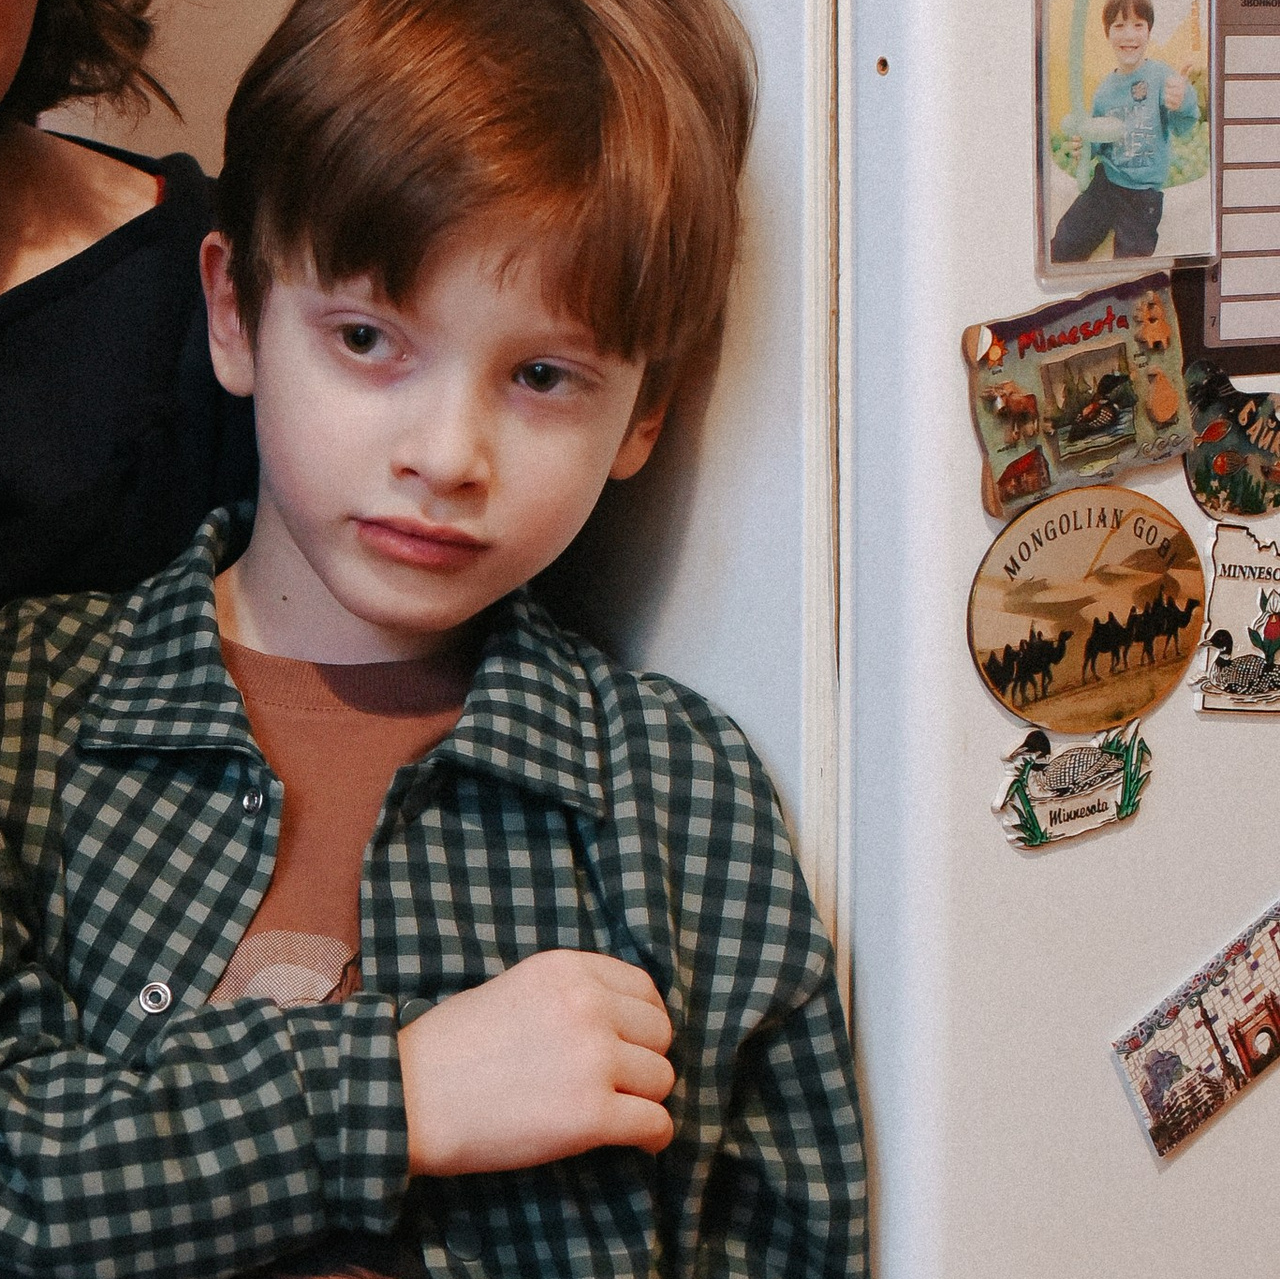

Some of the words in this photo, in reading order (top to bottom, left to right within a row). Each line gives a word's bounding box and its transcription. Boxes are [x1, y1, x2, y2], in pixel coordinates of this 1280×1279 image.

[1017, 305, 1130, 359] Minnesota
[1003, 507, 1123, 582] MONGOLIAN
[1133, 517, 1177, 568] GOBI
[1049, 798, 1110, 827] Minnesota
